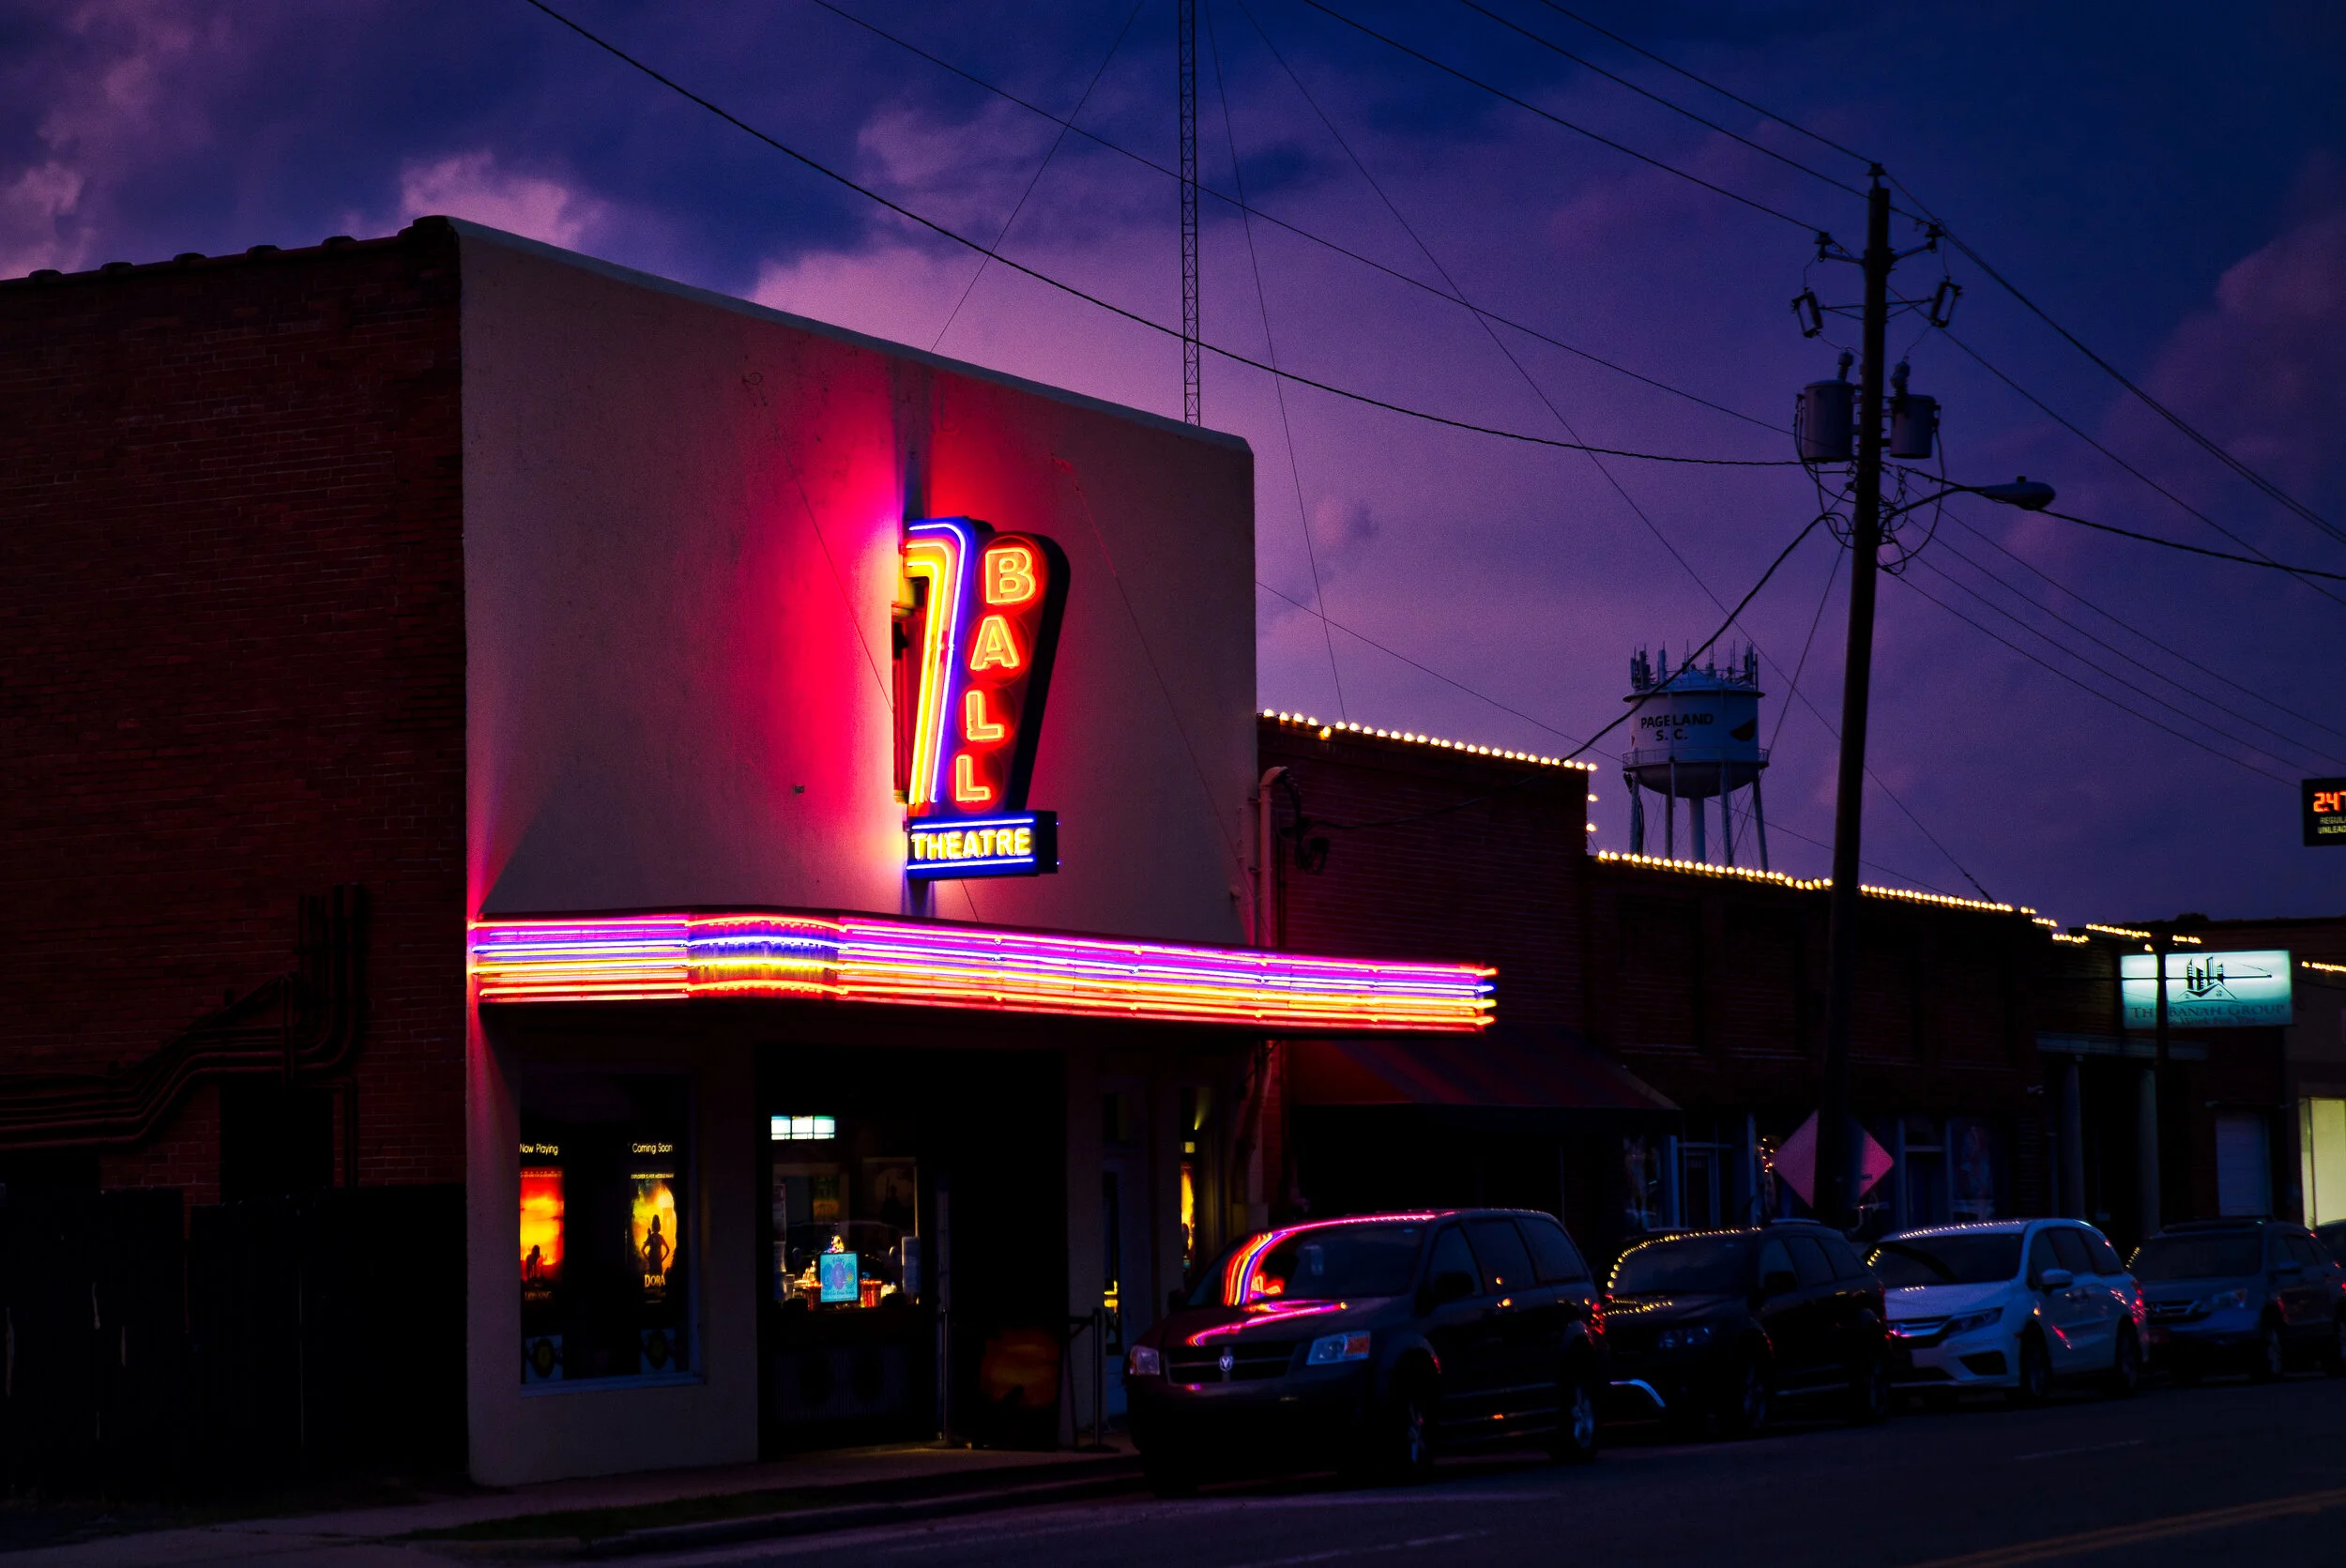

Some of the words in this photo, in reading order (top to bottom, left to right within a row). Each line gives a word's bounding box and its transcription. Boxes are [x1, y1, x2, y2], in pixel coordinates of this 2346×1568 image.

[954, 546, 1037, 802] BALL
[1641, 713, 1714, 729] PAGELAND
[910, 828, 1032, 860] THEATRE
[2228, 1004, 2284, 1016] GROUP
[519, 1143, 534, 1153] Now
[536, 1143, 559, 1156] Playing
[632, 1143, 656, 1155] Coming
[658, 1142, 673, 1152] Soon
[644, 1273, 666, 1288] DORA
